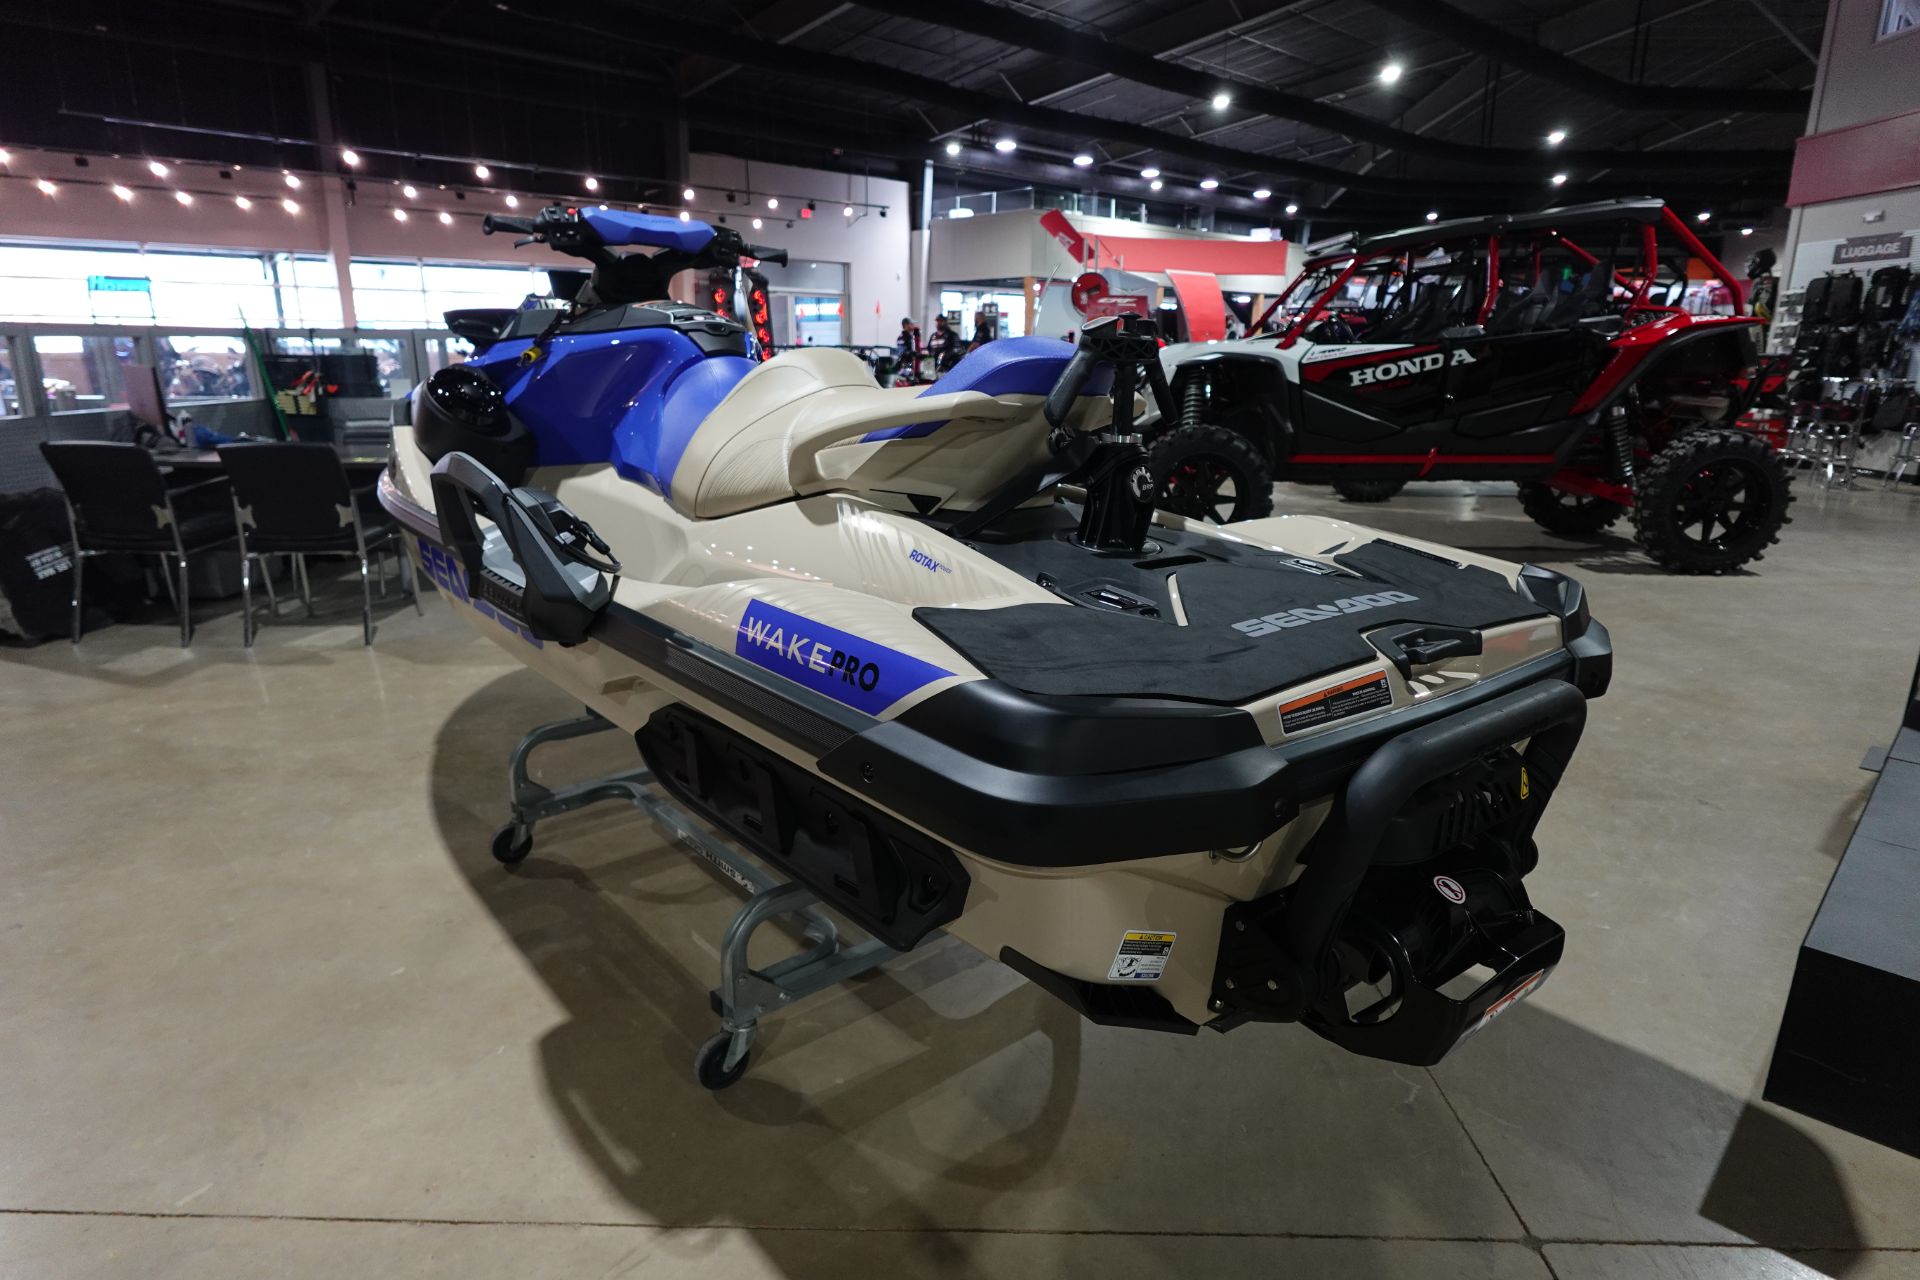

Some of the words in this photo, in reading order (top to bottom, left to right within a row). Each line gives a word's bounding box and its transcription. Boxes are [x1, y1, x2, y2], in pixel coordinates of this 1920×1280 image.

[1840, 242, 1901, 258] LUGGAGE
[1351, 348, 1477, 387] HONDA
[909, 549, 940, 573] ROTAX
